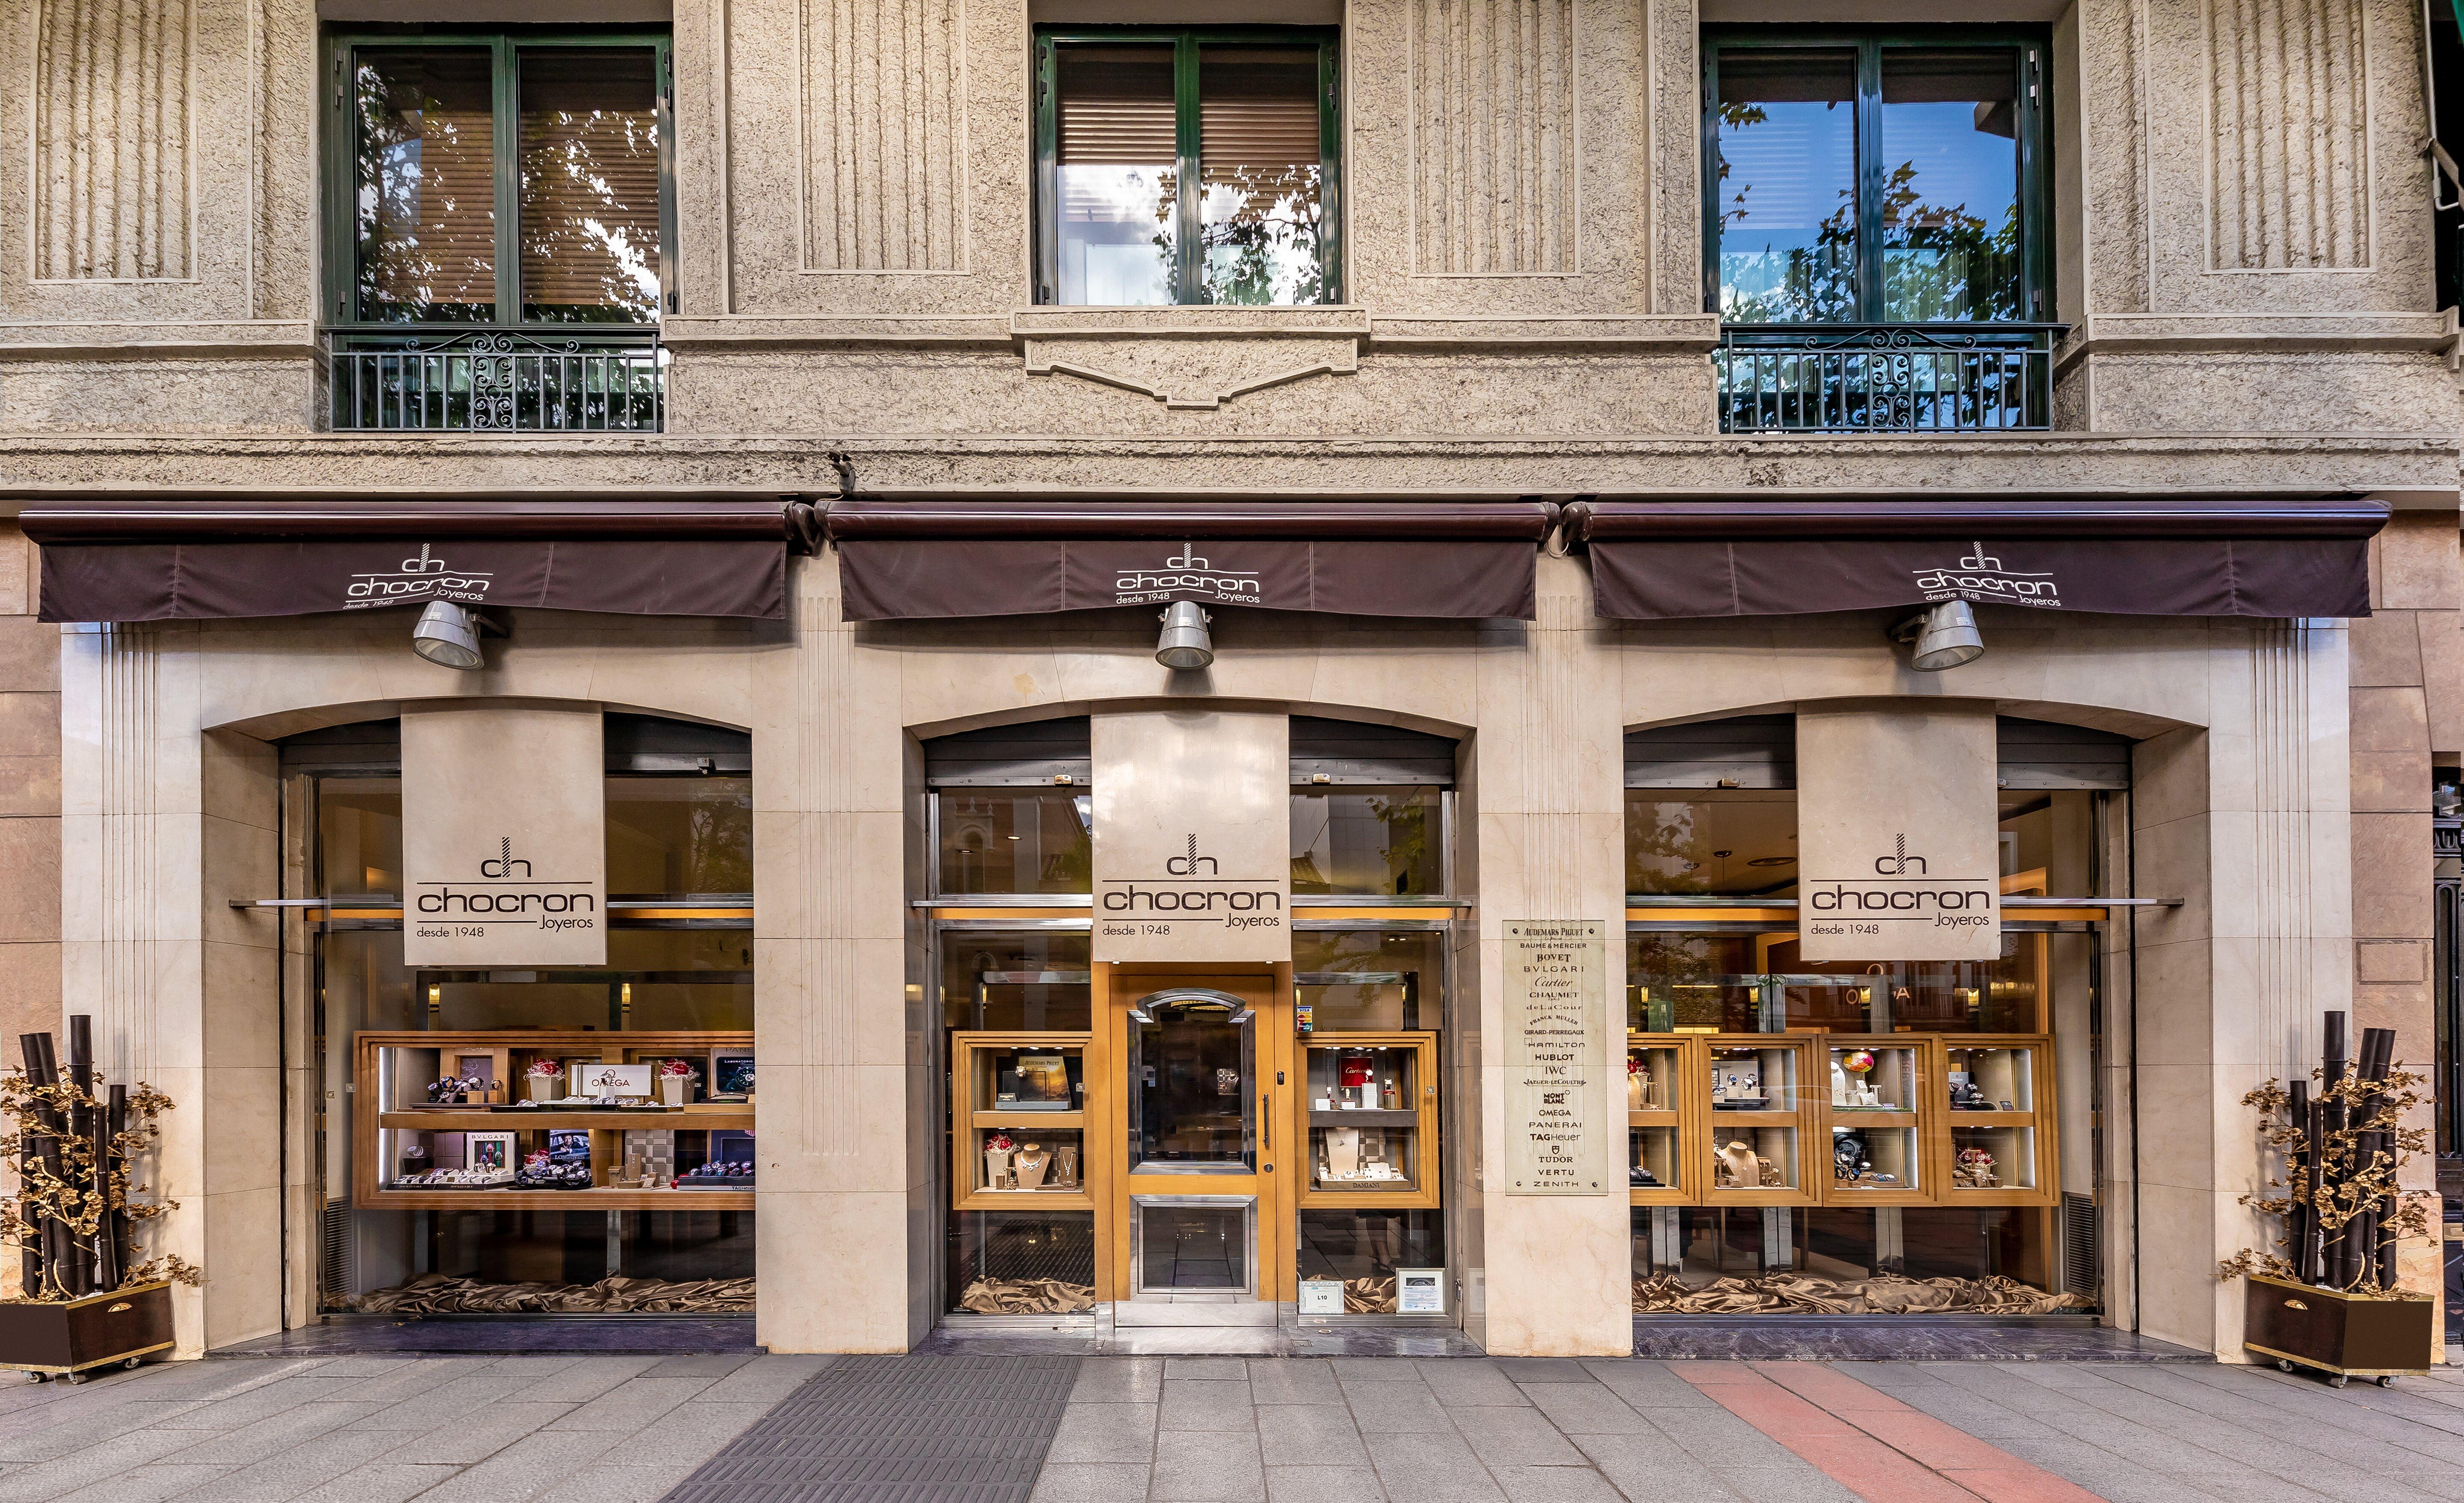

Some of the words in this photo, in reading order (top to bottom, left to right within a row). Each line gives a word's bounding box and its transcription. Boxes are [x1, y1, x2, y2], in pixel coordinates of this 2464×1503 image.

[348, 577, 489, 596] chocron
[1116, 573, 1259, 592] chocron
[1917, 572, 2057, 595] chocron
[433, 588, 483, 601] Joyeros
[1116, 596, 1144, 604] desde
[1148, 592, 1169, 602] 1948
[1215, 589, 1260, 603] Joyeros
[1926, 591, 1957, 600] desde
[1960, 591, 1980, 600] 1948
[2019, 594, 2061, 606] Joyeros
[417, 887, 594, 913] chocron
[1103, 885, 1281, 910] chocron
[1812, 884, 1990, 910] chocron
[539, 915, 593, 933] Joyeros
[1225, 912, 1280, 930] Joyeros
[1935, 912, 1989, 930] Joyeros
[417, 926, 450, 937] desde
[456, 927, 484, 937] 1948
[1102, 924, 1136, 935] desde
[1141, 925, 1170, 935] 1948
[1524, 928, 1559, 936] AUDEMARS
[1811, 924, 1844, 934] desde
[1849, 924, 1879, 934] 1948
[1537, 954, 1571, 962] BOVET
[1535, 976, 1572, 987] Cartier
[1529, 1015, 1552, 1025] FRANCK
[1556, 1015, 1578, 1025] MULLER
[1545, 1066, 1567, 1075] IWC
